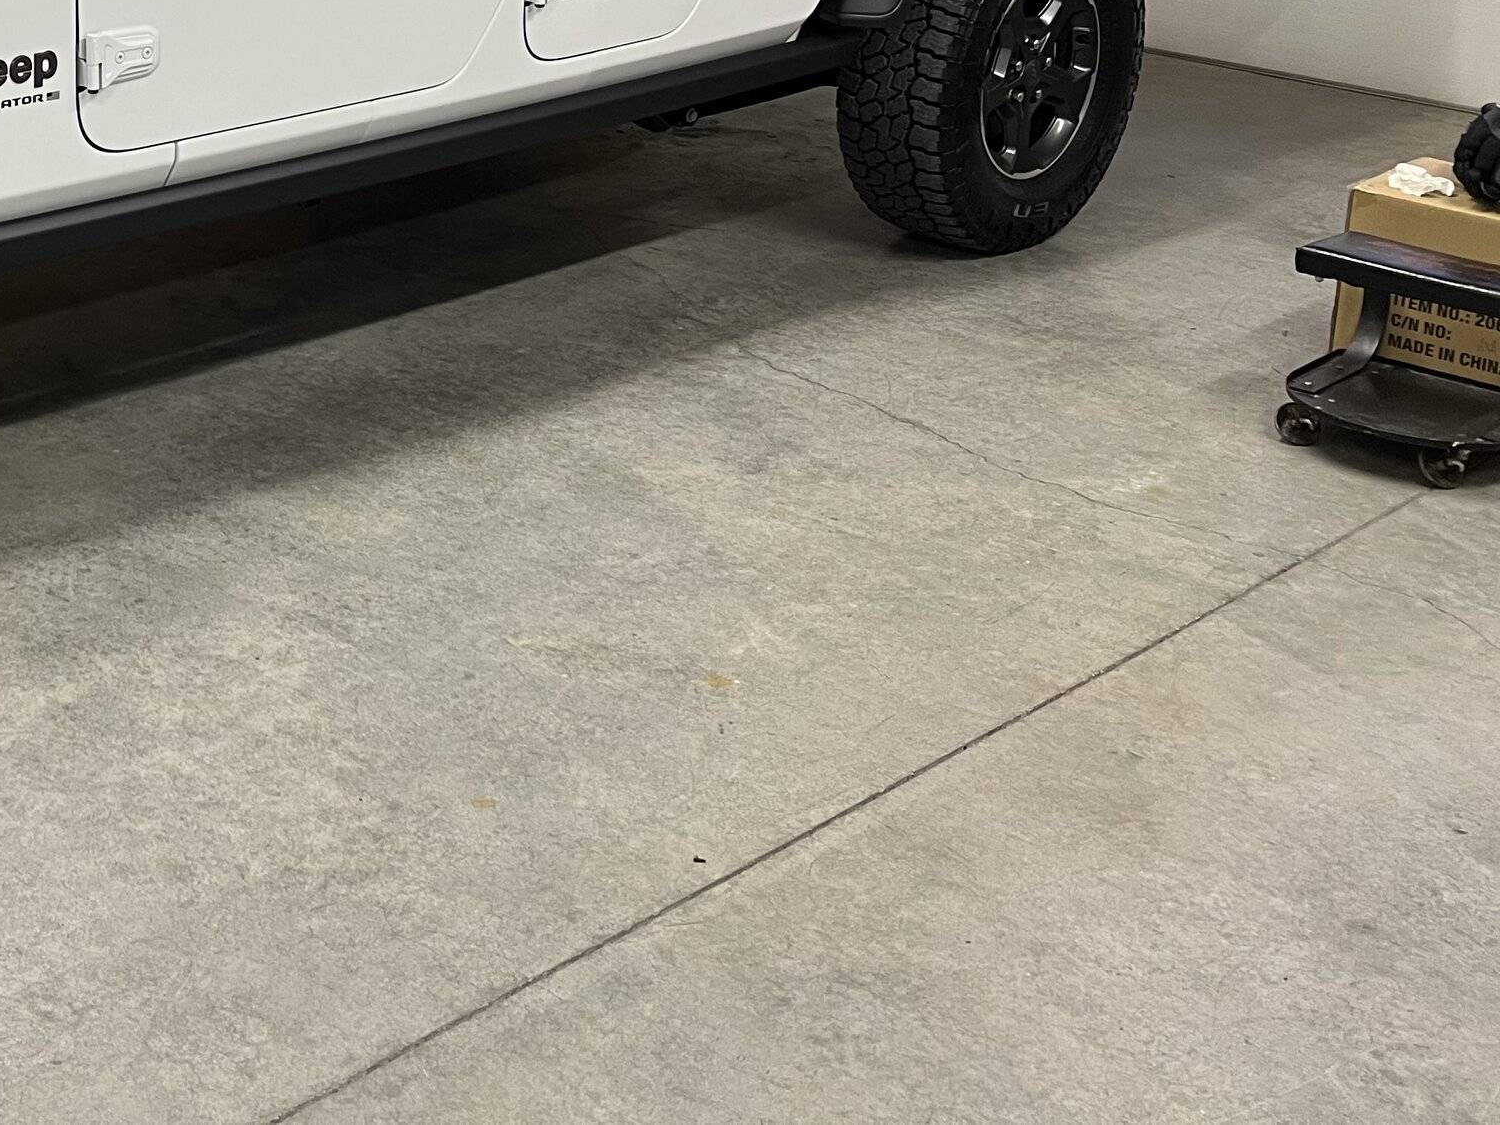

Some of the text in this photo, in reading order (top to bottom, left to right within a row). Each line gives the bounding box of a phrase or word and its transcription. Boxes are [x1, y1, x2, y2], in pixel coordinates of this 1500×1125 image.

[1393, 295, 1432, 314] ITEM
[1391, 314, 1452, 340] C/N NO:
[1388, 333, 1500, 375] MADE IN CHIN
